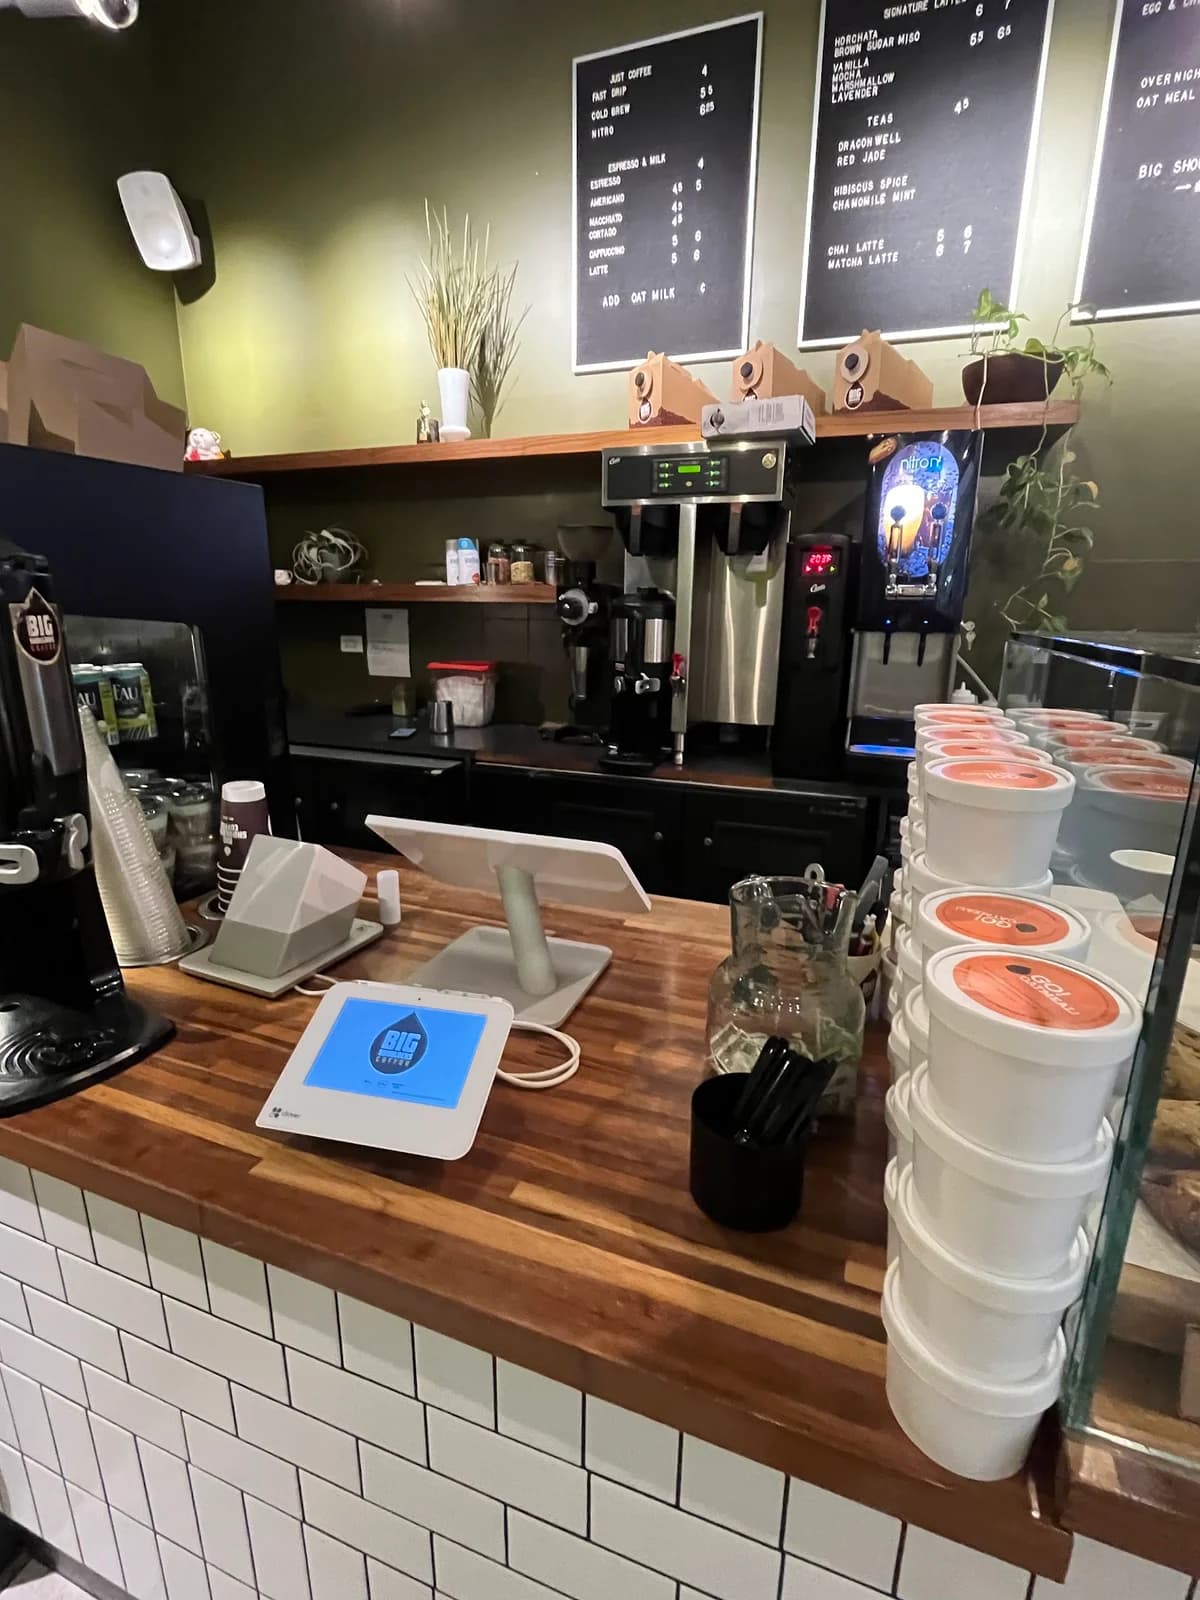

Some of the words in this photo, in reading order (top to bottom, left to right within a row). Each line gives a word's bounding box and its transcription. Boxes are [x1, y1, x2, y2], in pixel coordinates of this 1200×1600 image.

[883, 0, 929, 19] SIGNATURE
[976, 4, 983, 16] 6
[834, 29, 878, 47] HORCHATA
[834, 43, 862, 58] BROWN
[867, 36, 895, 51] SUGAR
[897, 30, 921, 45] MISO
[701, 64, 707, 77] 4
[833, 56, 869, 73] VANILLA
[610, 71, 625, 84] JUST
[628, 65, 652, 80] COFFEE
[832, 69, 861, 83] MOCHA
[832, 72, 895, 93] MARSHMALLOW
[592, 90, 607, 103] FAST
[611, 85, 627, 98] DRIP
[831, 85, 879, 104] LAVENDER
[1137, 94, 1159, 108] OAT
[1164, 89, 1195, 104] MEAL
[591, 108, 609, 121] COLD
[611, 103, 631, 117] BREW
[867, 113, 894, 127] TEAS
[591, 125, 614, 139] NITRO
[608, 158, 639, 173] ESPRESSO
[649, 153, 666, 166] MILK
[697, 156, 703, 170] 4
[836, 154, 855, 167] RED
[862, 149, 886, 164] JADE
[1138, 162, 1163, 179] BIG
[590, 175, 621, 190] ESPRESSO
[833, 180, 874, 197] HIBISCUS
[880, 175, 908, 190] SPICE
[590, 193, 625, 208] AMERICANO
[832, 192, 886, 211] CHAMOMILE
[892, 189, 916, 203] MINT
[589, 213, 623, 227] MACCHIATO
[588, 227, 617, 240] CORTADO
[589, 245, 625, 260] CAPPUCCINO
[828, 243, 849, 256] CHAI
[856, 239, 885, 253] LATTE
[964, 240, 971, 254] 7
[828, 254, 863, 270] MATCHA
[869, 251, 899, 265] LATTE
[589, 264, 609, 276] LATTE
[602, 294, 620, 308] ADD
[631, 290, 647, 304] OAT
[652, 287, 675, 301] MILK
[25, 614, 54, 637] BIG
[1030, 975, 1072, 997] GO!
[381, 1030, 421, 1053] BIG
